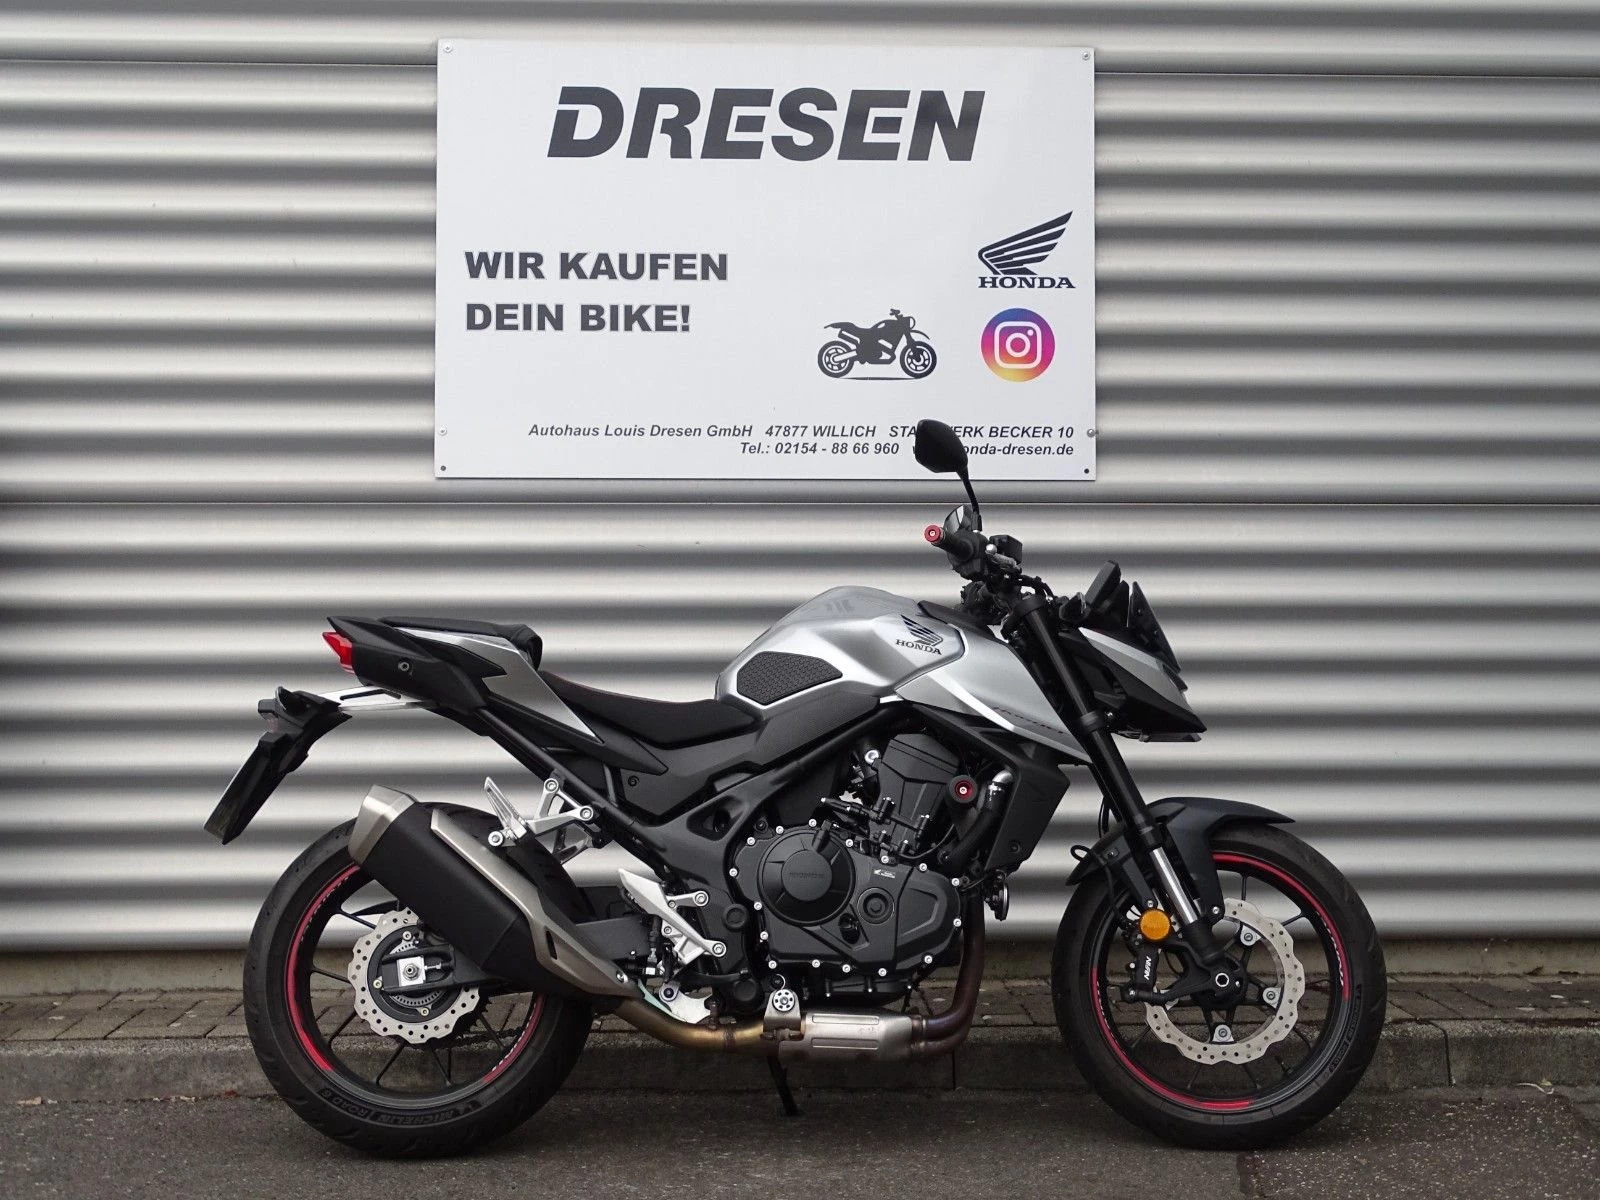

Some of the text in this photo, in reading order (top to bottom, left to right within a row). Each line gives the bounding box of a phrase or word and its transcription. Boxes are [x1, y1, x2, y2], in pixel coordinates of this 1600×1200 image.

[547, 86, 986, 162] DRESEN
[464, 252, 728, 281] WIR KAUFEN
[977, 276, 1076, 290] HONDA
[465, 303, 690, 332] DEIN BIKE!
[528, 424, 1074, 439] Autohaus Louis Dresen GmbH 47877 WILLICH STAERK BECKER 10
[740, 442, 770, 454] Tel.:
[774, 442, 818, 455] 02154
[831, 442, 849, 455] 88
[852, 442, 870, 455] 66
[873, 442, 900, 455] 960
[895, 639, 943, 656] HONDA
